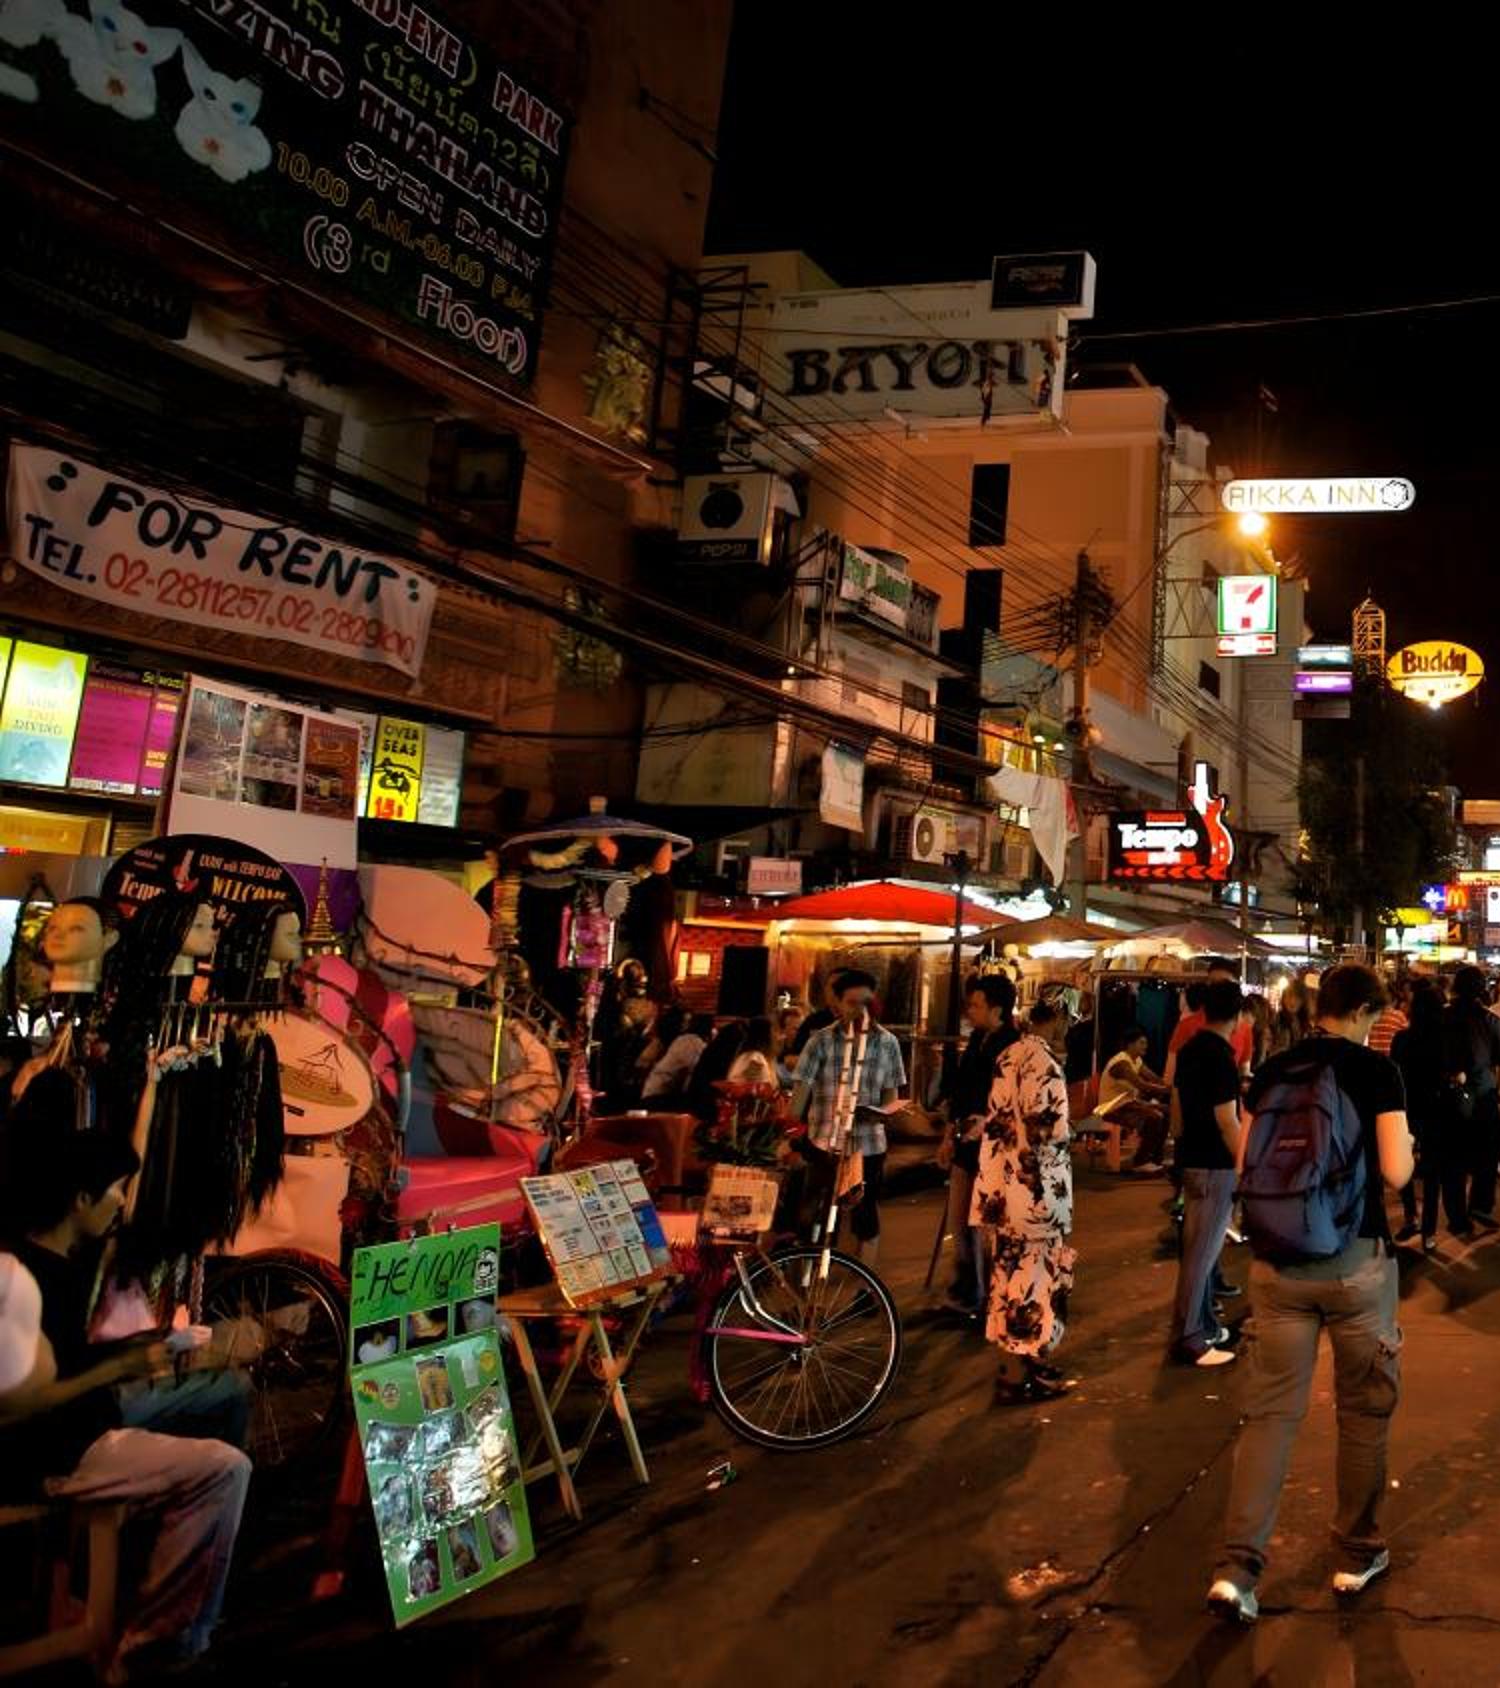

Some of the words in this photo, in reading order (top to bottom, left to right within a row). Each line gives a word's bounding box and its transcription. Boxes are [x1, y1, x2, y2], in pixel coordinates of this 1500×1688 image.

[491, 71, 564, 156] PARK
[276, 140, 351, 208] 10.00
[358, 78, 552, 239] THAILAND
[345, 141, 444, 226] OPEN
[455, 207, 544, 284] DAILY
[416, 273, 529, 375] Floor)
[1327, 484, 1376, 505] INN
[25, 514, 97, 583] TEL.
[88, 483, 222, 559] FOR
[239, 527, 398, 602] RENT
[1401, 648, 1468, 675] Buddy
[383, 740, 417, 757] SEAS
[384, 725, 419, 740] OVER
[1117, 823, 1199, 852] Tempo
